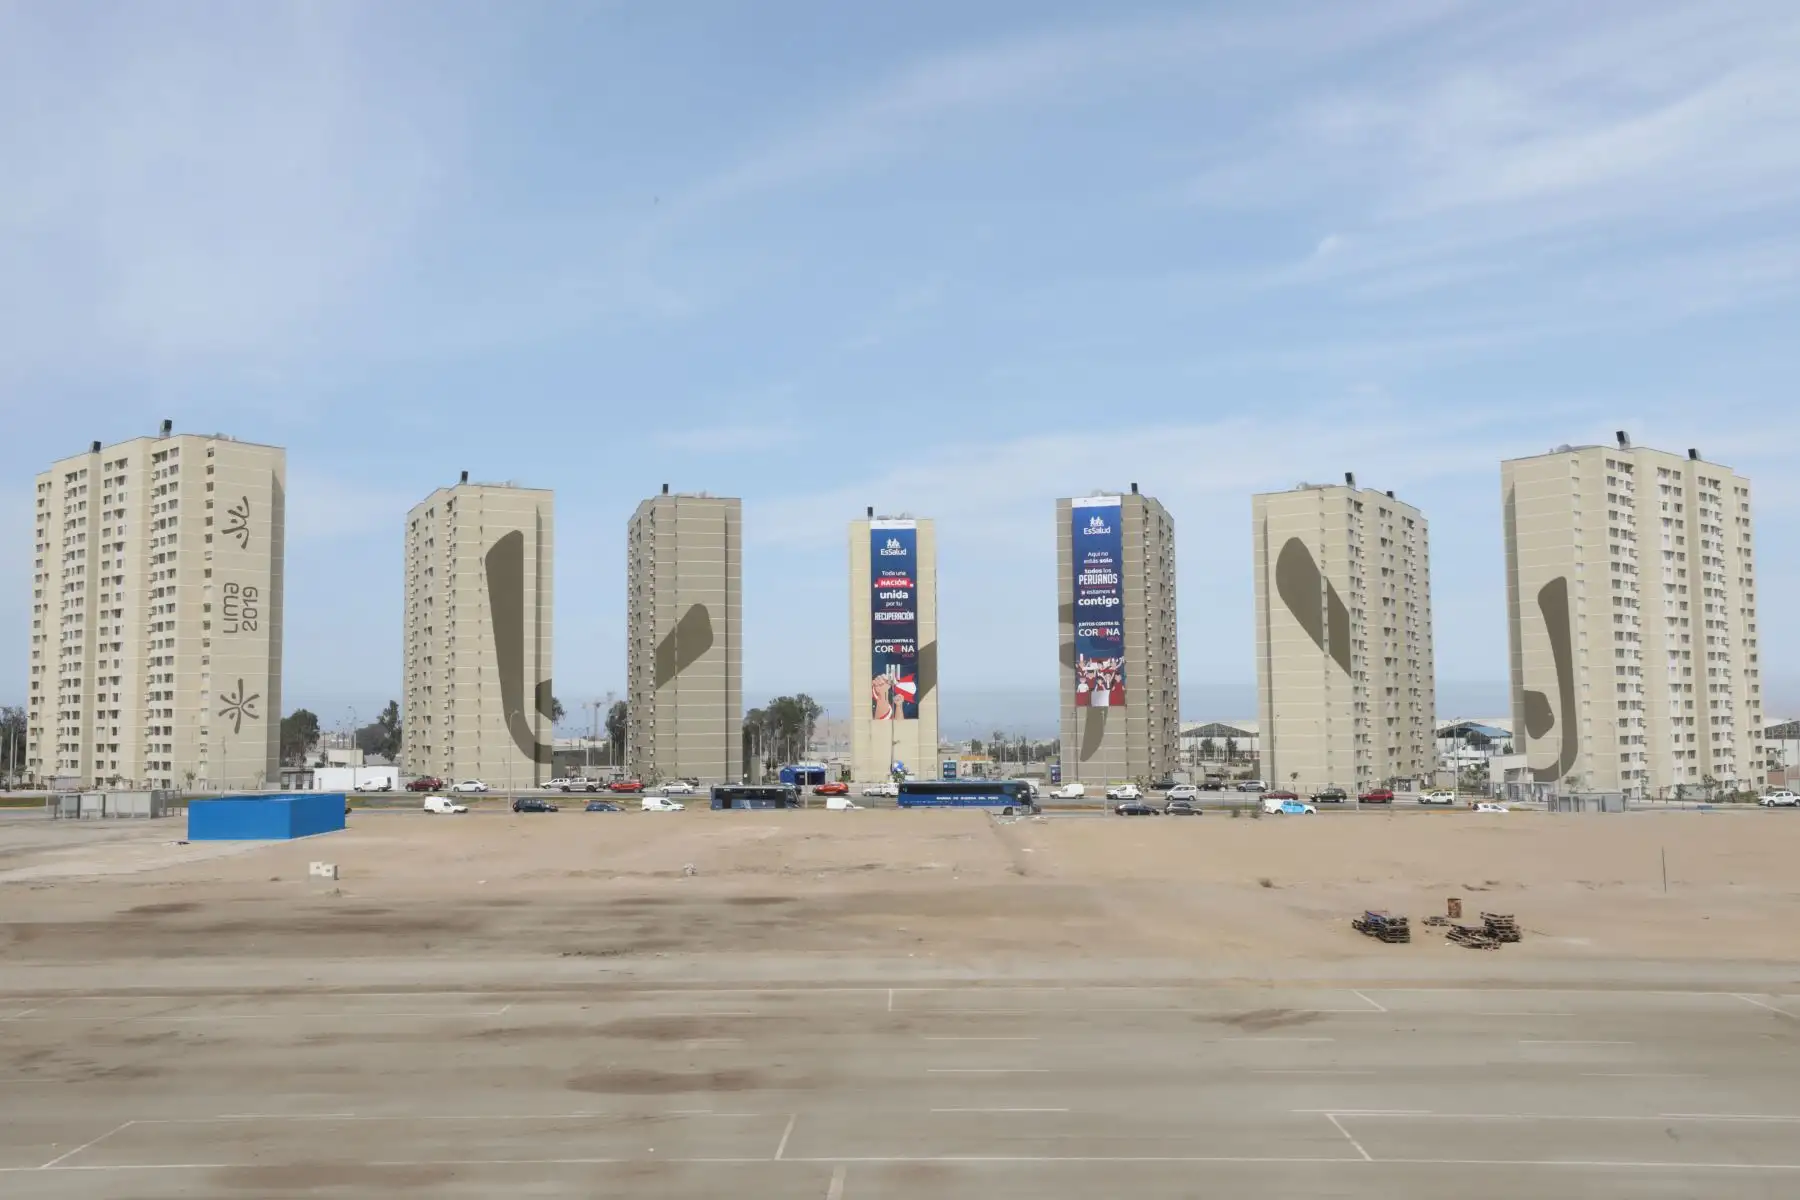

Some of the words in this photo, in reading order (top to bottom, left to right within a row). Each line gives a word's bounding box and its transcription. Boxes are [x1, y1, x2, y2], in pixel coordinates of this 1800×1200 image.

[1084, 526, 1110, 534] EsSalud
[1078, 574, 1118, 585] PERUANOS
[880, 590, 908, 599] unida
[1078, 596, 1120, 607] contigo
[242, 586, 258, 631] 2019
[874, 610, 914, 620] RECUPERACIÓN
